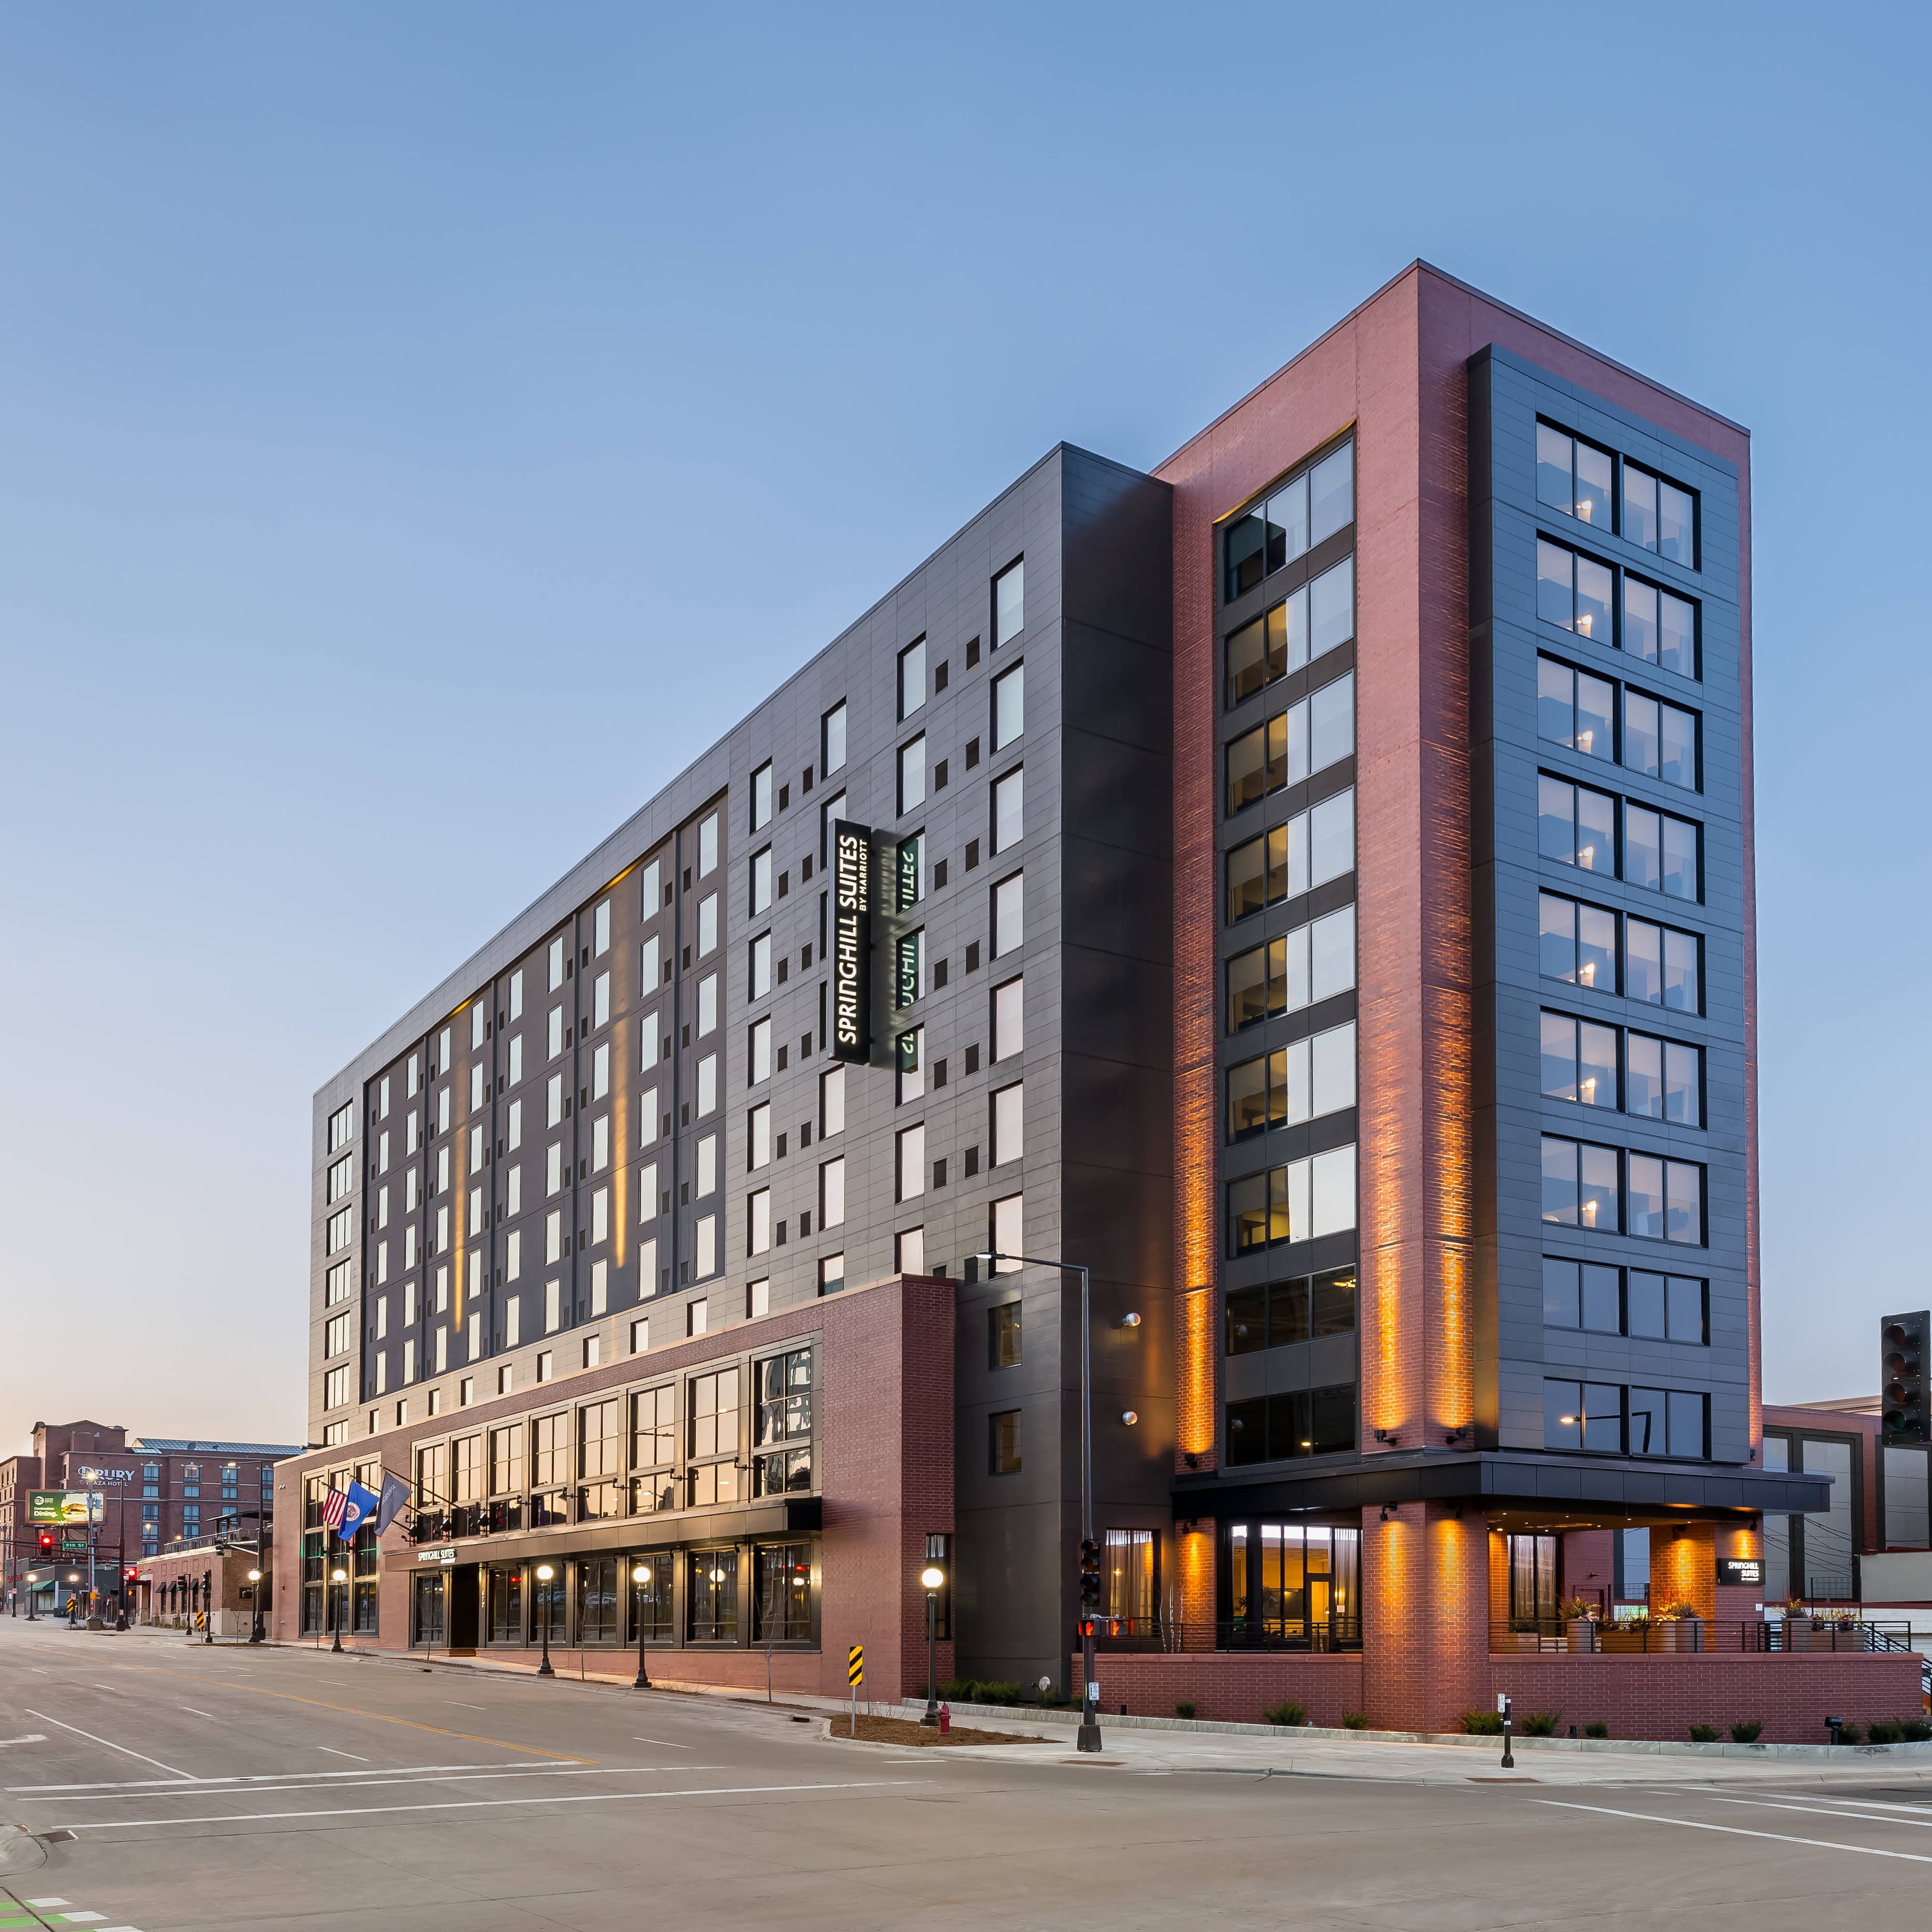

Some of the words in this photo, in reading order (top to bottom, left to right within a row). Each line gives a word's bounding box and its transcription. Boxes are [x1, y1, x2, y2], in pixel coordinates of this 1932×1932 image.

[839, 835, 857, 910] SUITES
[859, 839, 867, 895] MARRIOTT
[859, 898, 867, 912] BY
[838, 915, 857, 1045] SPRINGHILL
[77, 1466, 135, 1481] DRURY
[1728, 1561, 1759, 1570] SPRINGHILL
